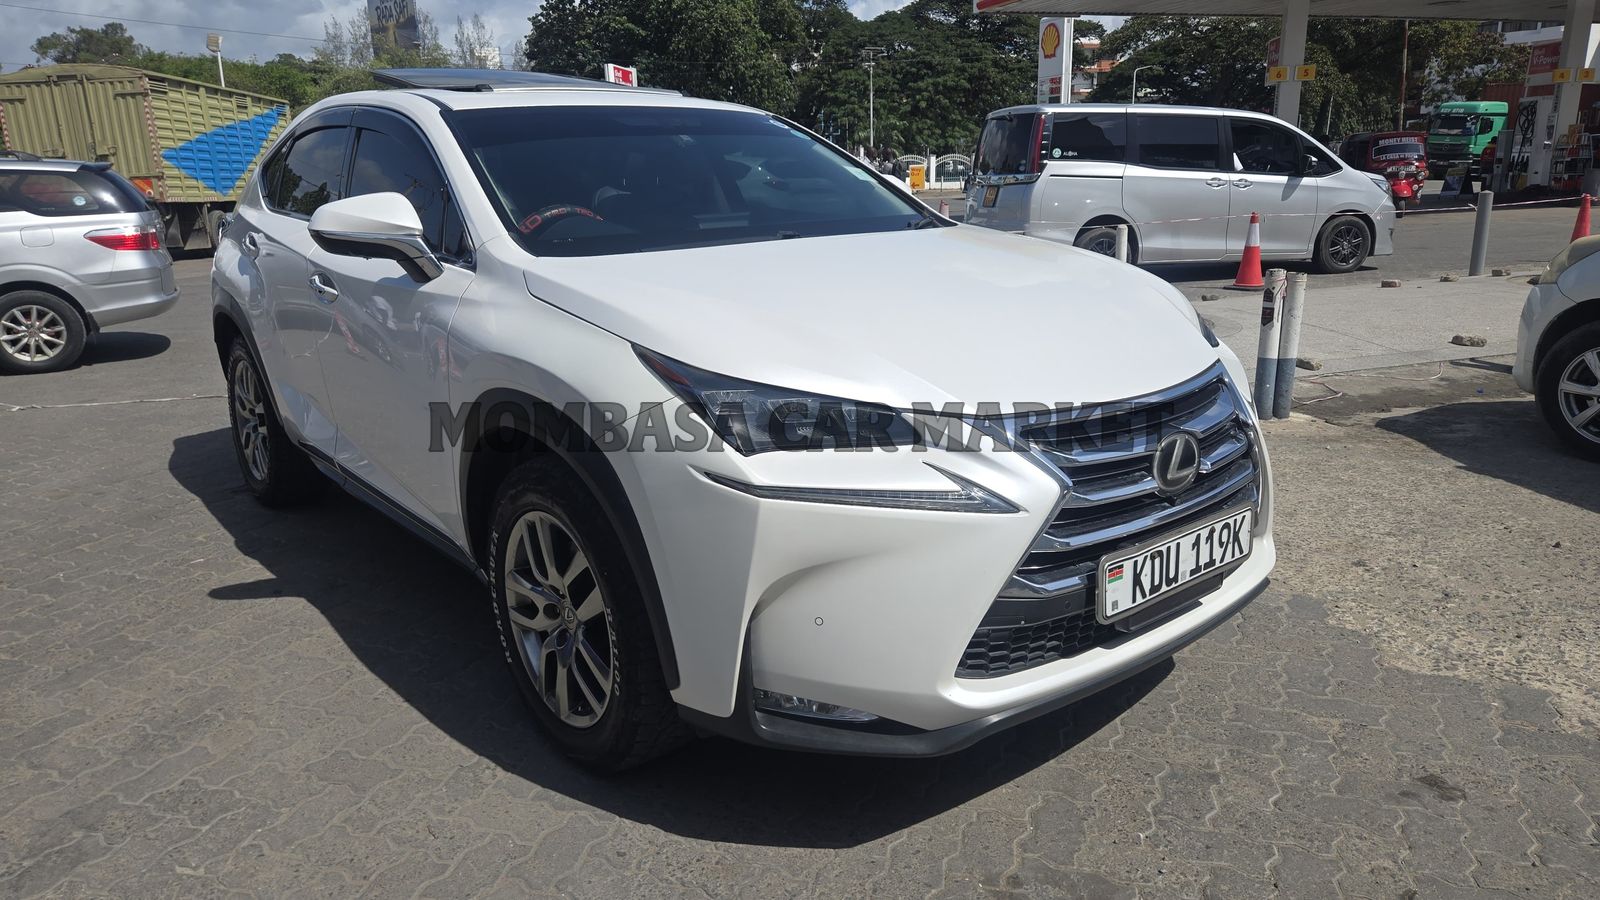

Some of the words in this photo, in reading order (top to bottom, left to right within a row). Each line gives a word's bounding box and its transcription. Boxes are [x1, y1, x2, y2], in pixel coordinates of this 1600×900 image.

[375, 4, 395, 28] RADA
[1275, 71, 1282, 79] 6
[1303, 69, 1309, 77] 5
[1378, 138, 1400, 146] MONEY
[1401, 136, 1418, 144] HEIST
[1132, 542, 1181, 604] KDU
[1189, 514, 1246, 578] 119K
